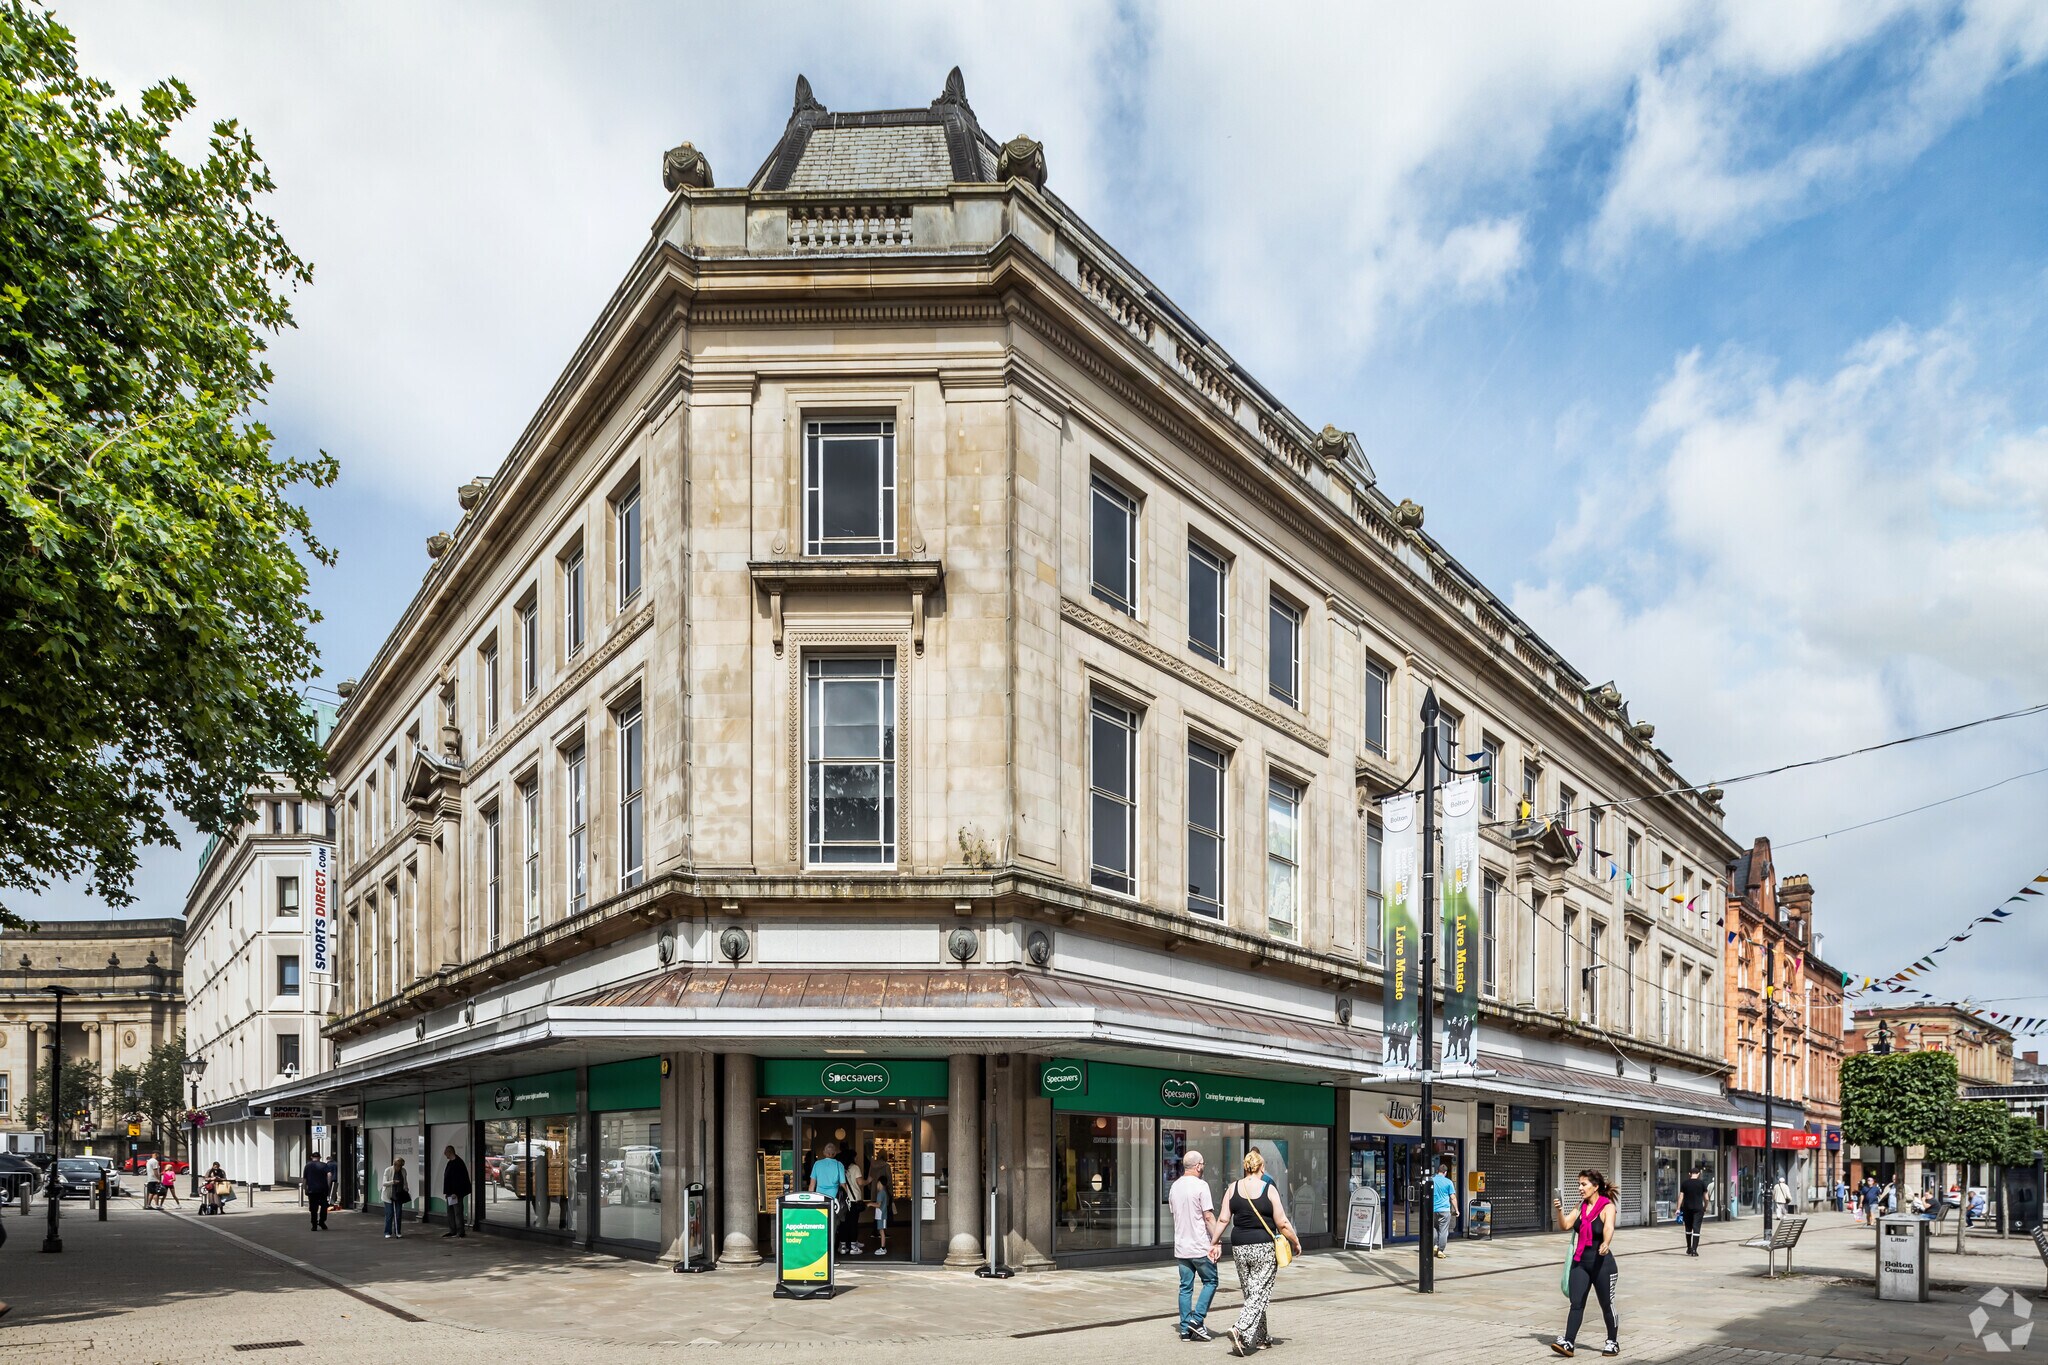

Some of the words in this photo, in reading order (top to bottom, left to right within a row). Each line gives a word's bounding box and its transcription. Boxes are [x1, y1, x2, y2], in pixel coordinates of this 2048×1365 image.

[1451, 800, 1470, 808] Bolton
[1457, 914, 1467, 947] Live
[315, 919, 326, 970] SPORTS
[1395, 926, 1406, 956] Live
[1456, 949, 1467, 994] Music
[1395, 958, 1406, 1001] Music
[828, 1072, 883, 1084] Specsavers
[1046, 1074, 1079, 1084] Specsavers
[1164, 1088, 1196, 1100] Specsavers
[1205, 1093, 1218, 1102] Caring
[1225, 1095, 1234, 1103] your
[1234, 1095, 1244, 1104] sight
[1389, 1101, 1414, 1121] Hays
[1416, 1103, 1446, 1123] Tvel
[1496, 1114, 1500, 1126] TO
[785, 1223, 825, 1232] Appointments
[1884, 1260, 1914, 1269] Bolton
[1884, 1267, 1914, 1275] Council
